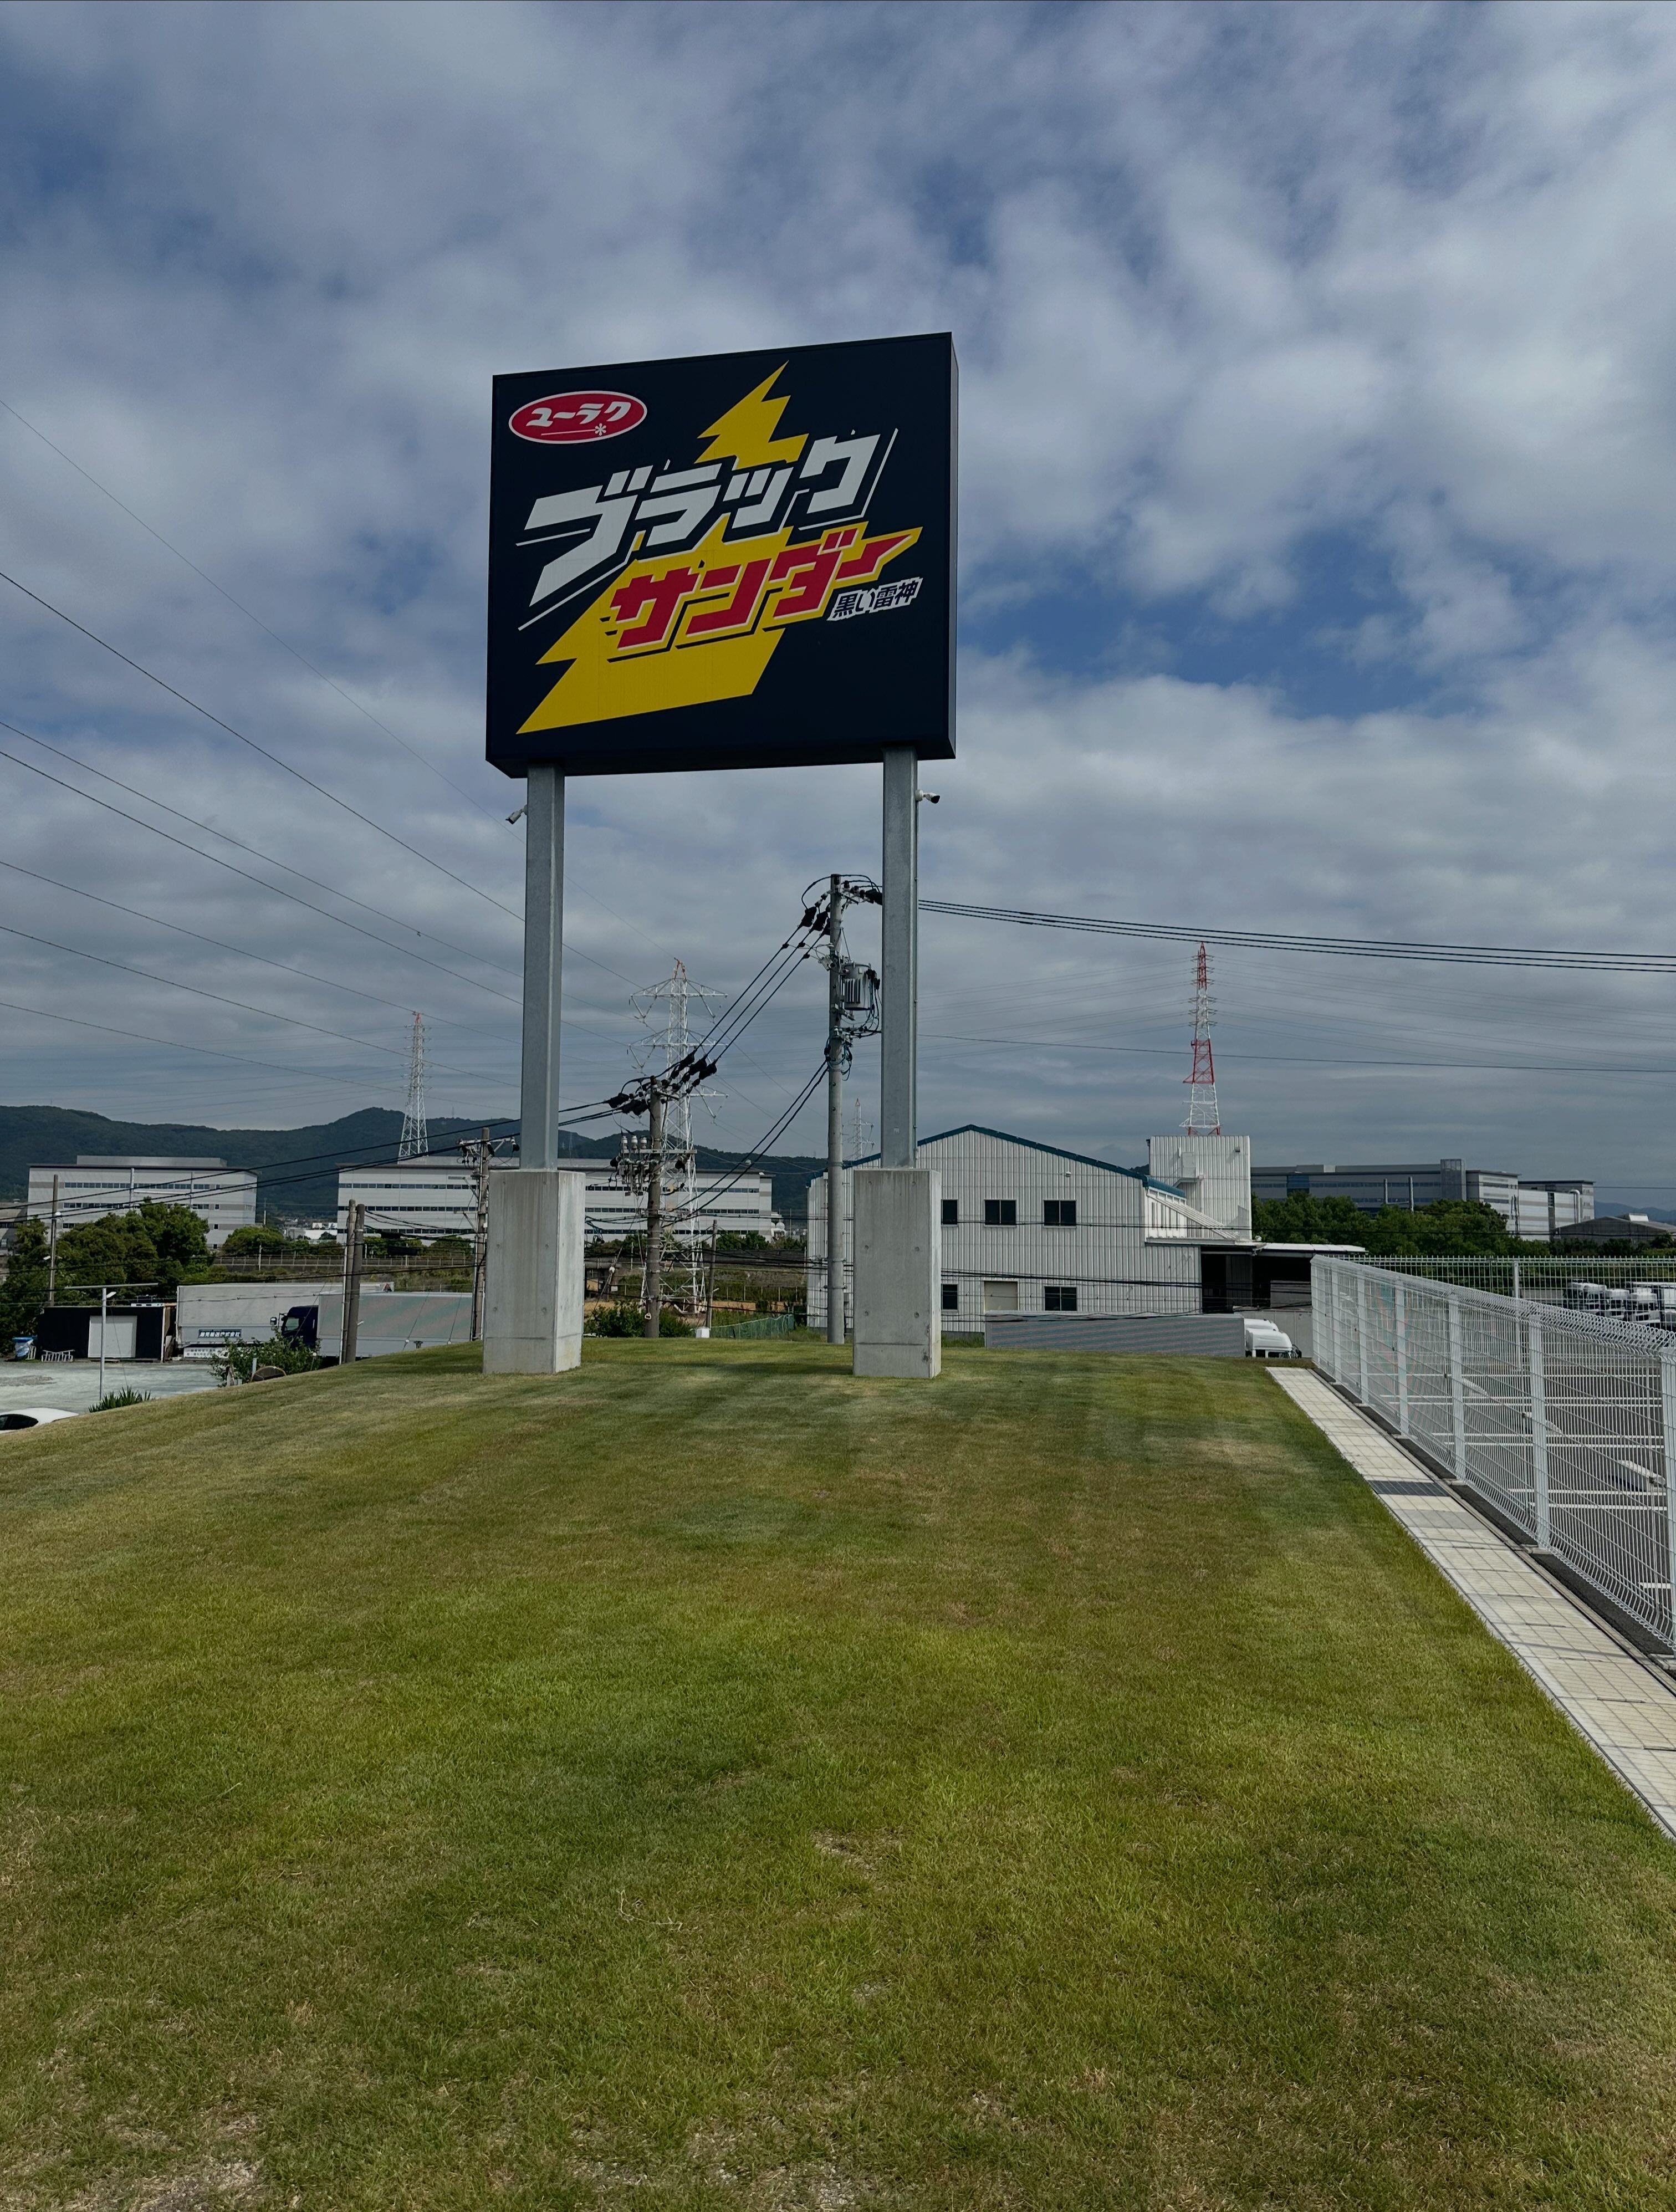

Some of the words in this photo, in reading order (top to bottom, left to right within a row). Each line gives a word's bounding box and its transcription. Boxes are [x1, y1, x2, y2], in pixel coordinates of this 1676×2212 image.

[526, 401, 631, 427] ユーラク
[524, 433, 881, 607] ブラック
[610, 528, 918, 651] サンダー
[832, 580, 918, 619] 黒い雷神
